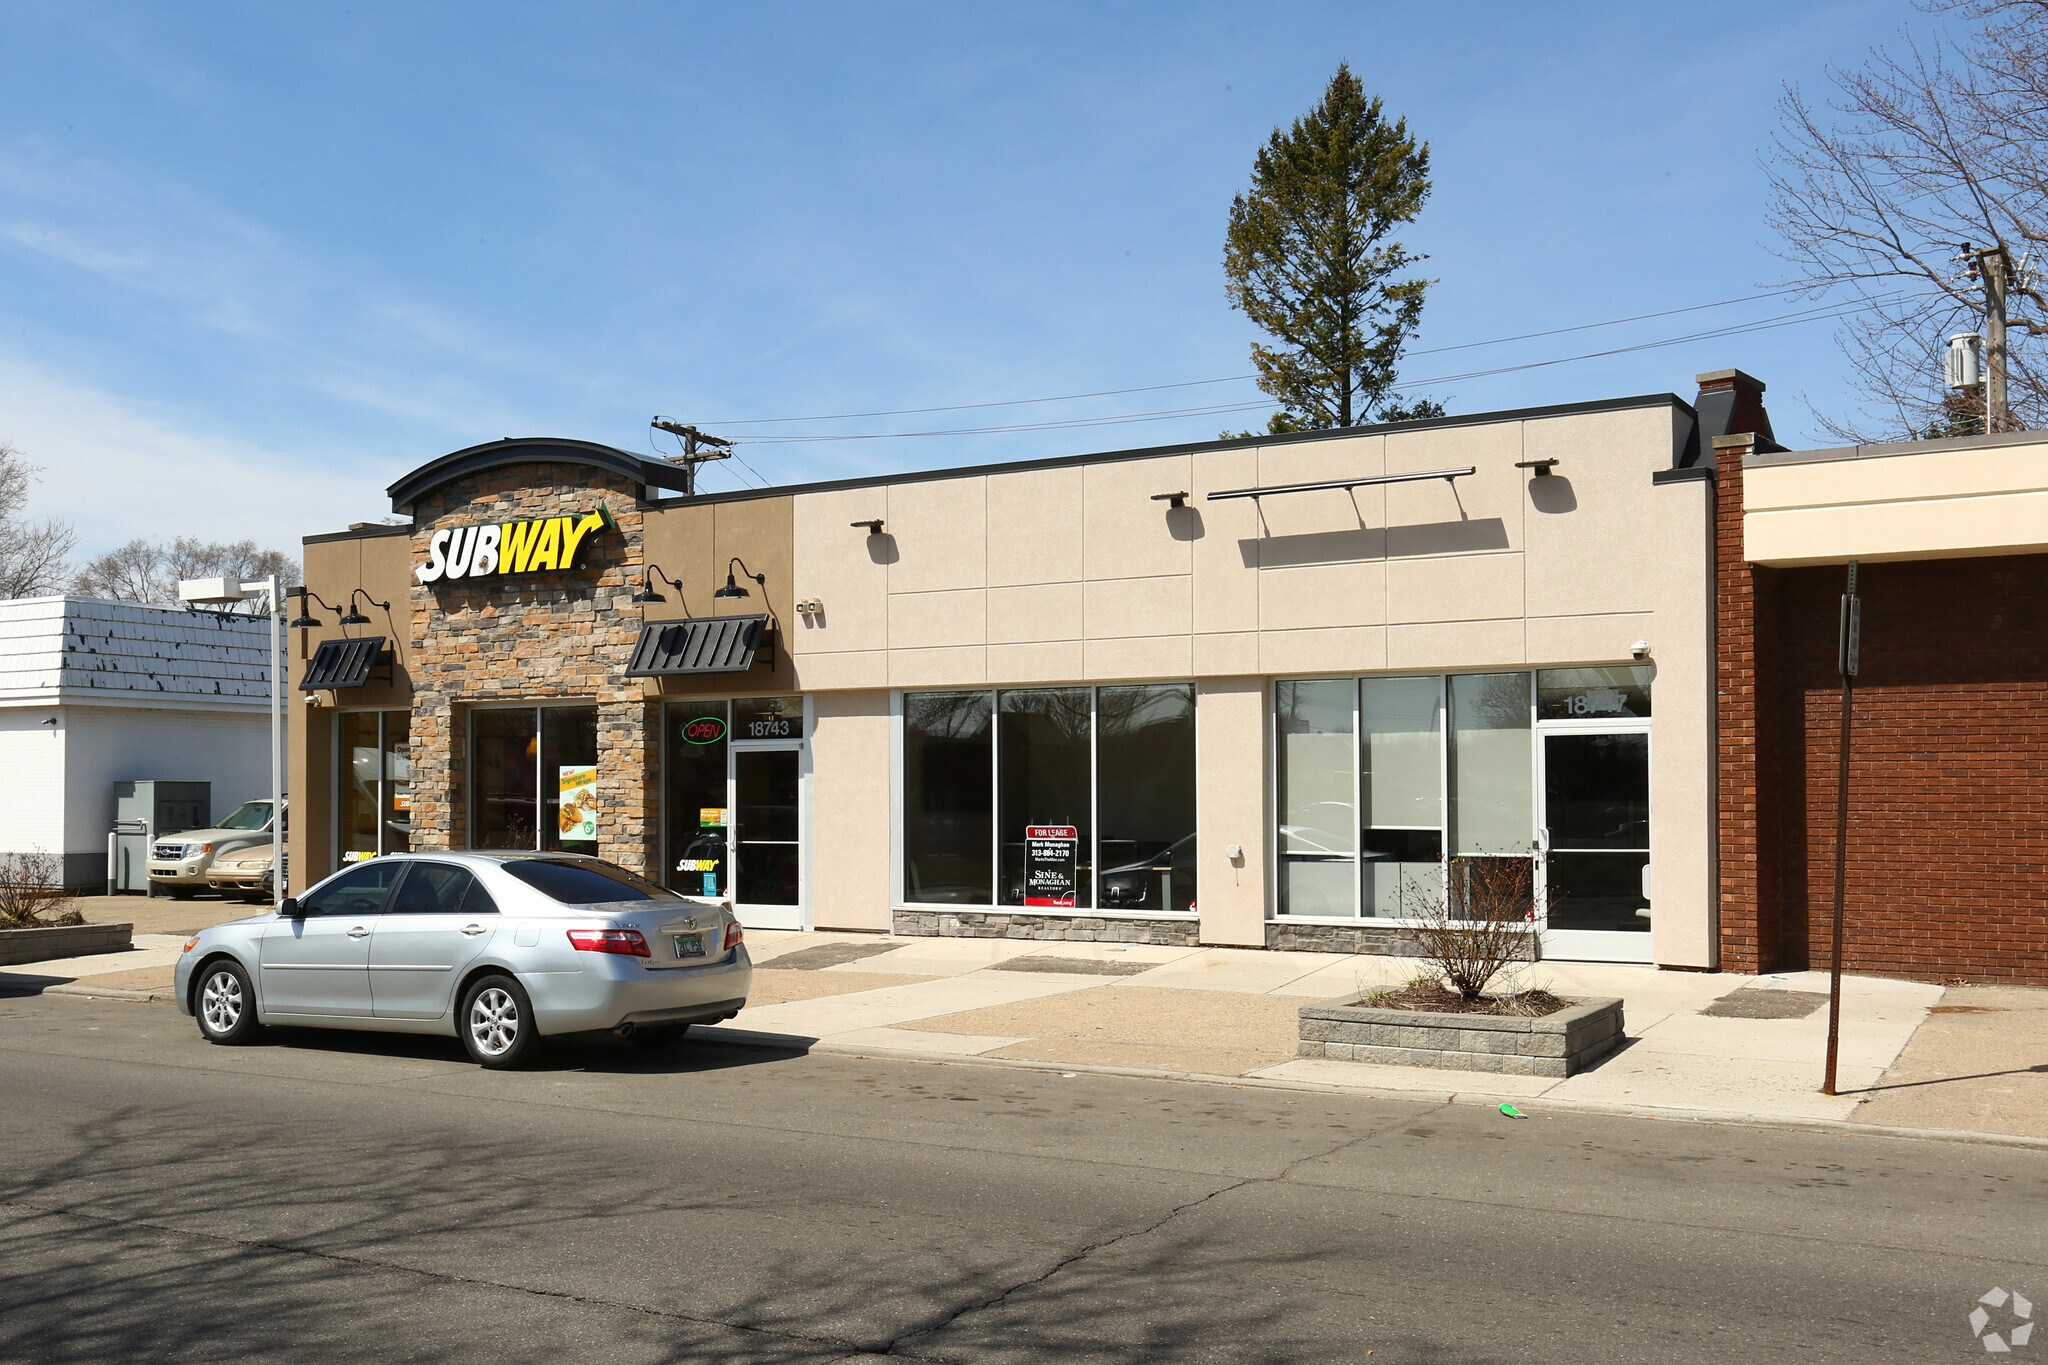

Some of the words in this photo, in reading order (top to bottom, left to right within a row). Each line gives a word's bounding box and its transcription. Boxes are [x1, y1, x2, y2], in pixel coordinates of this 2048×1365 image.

[415, 509, 605, 585] SUBWAY
[687, 723, 720, 738] OPEN
[748, 720, 790, 736] 18743
[1048, 829, 1068, 837] LEASE
[343, 851, 377, 862] SUBWAY
[676, 859, 720, 872] SUBWAY
